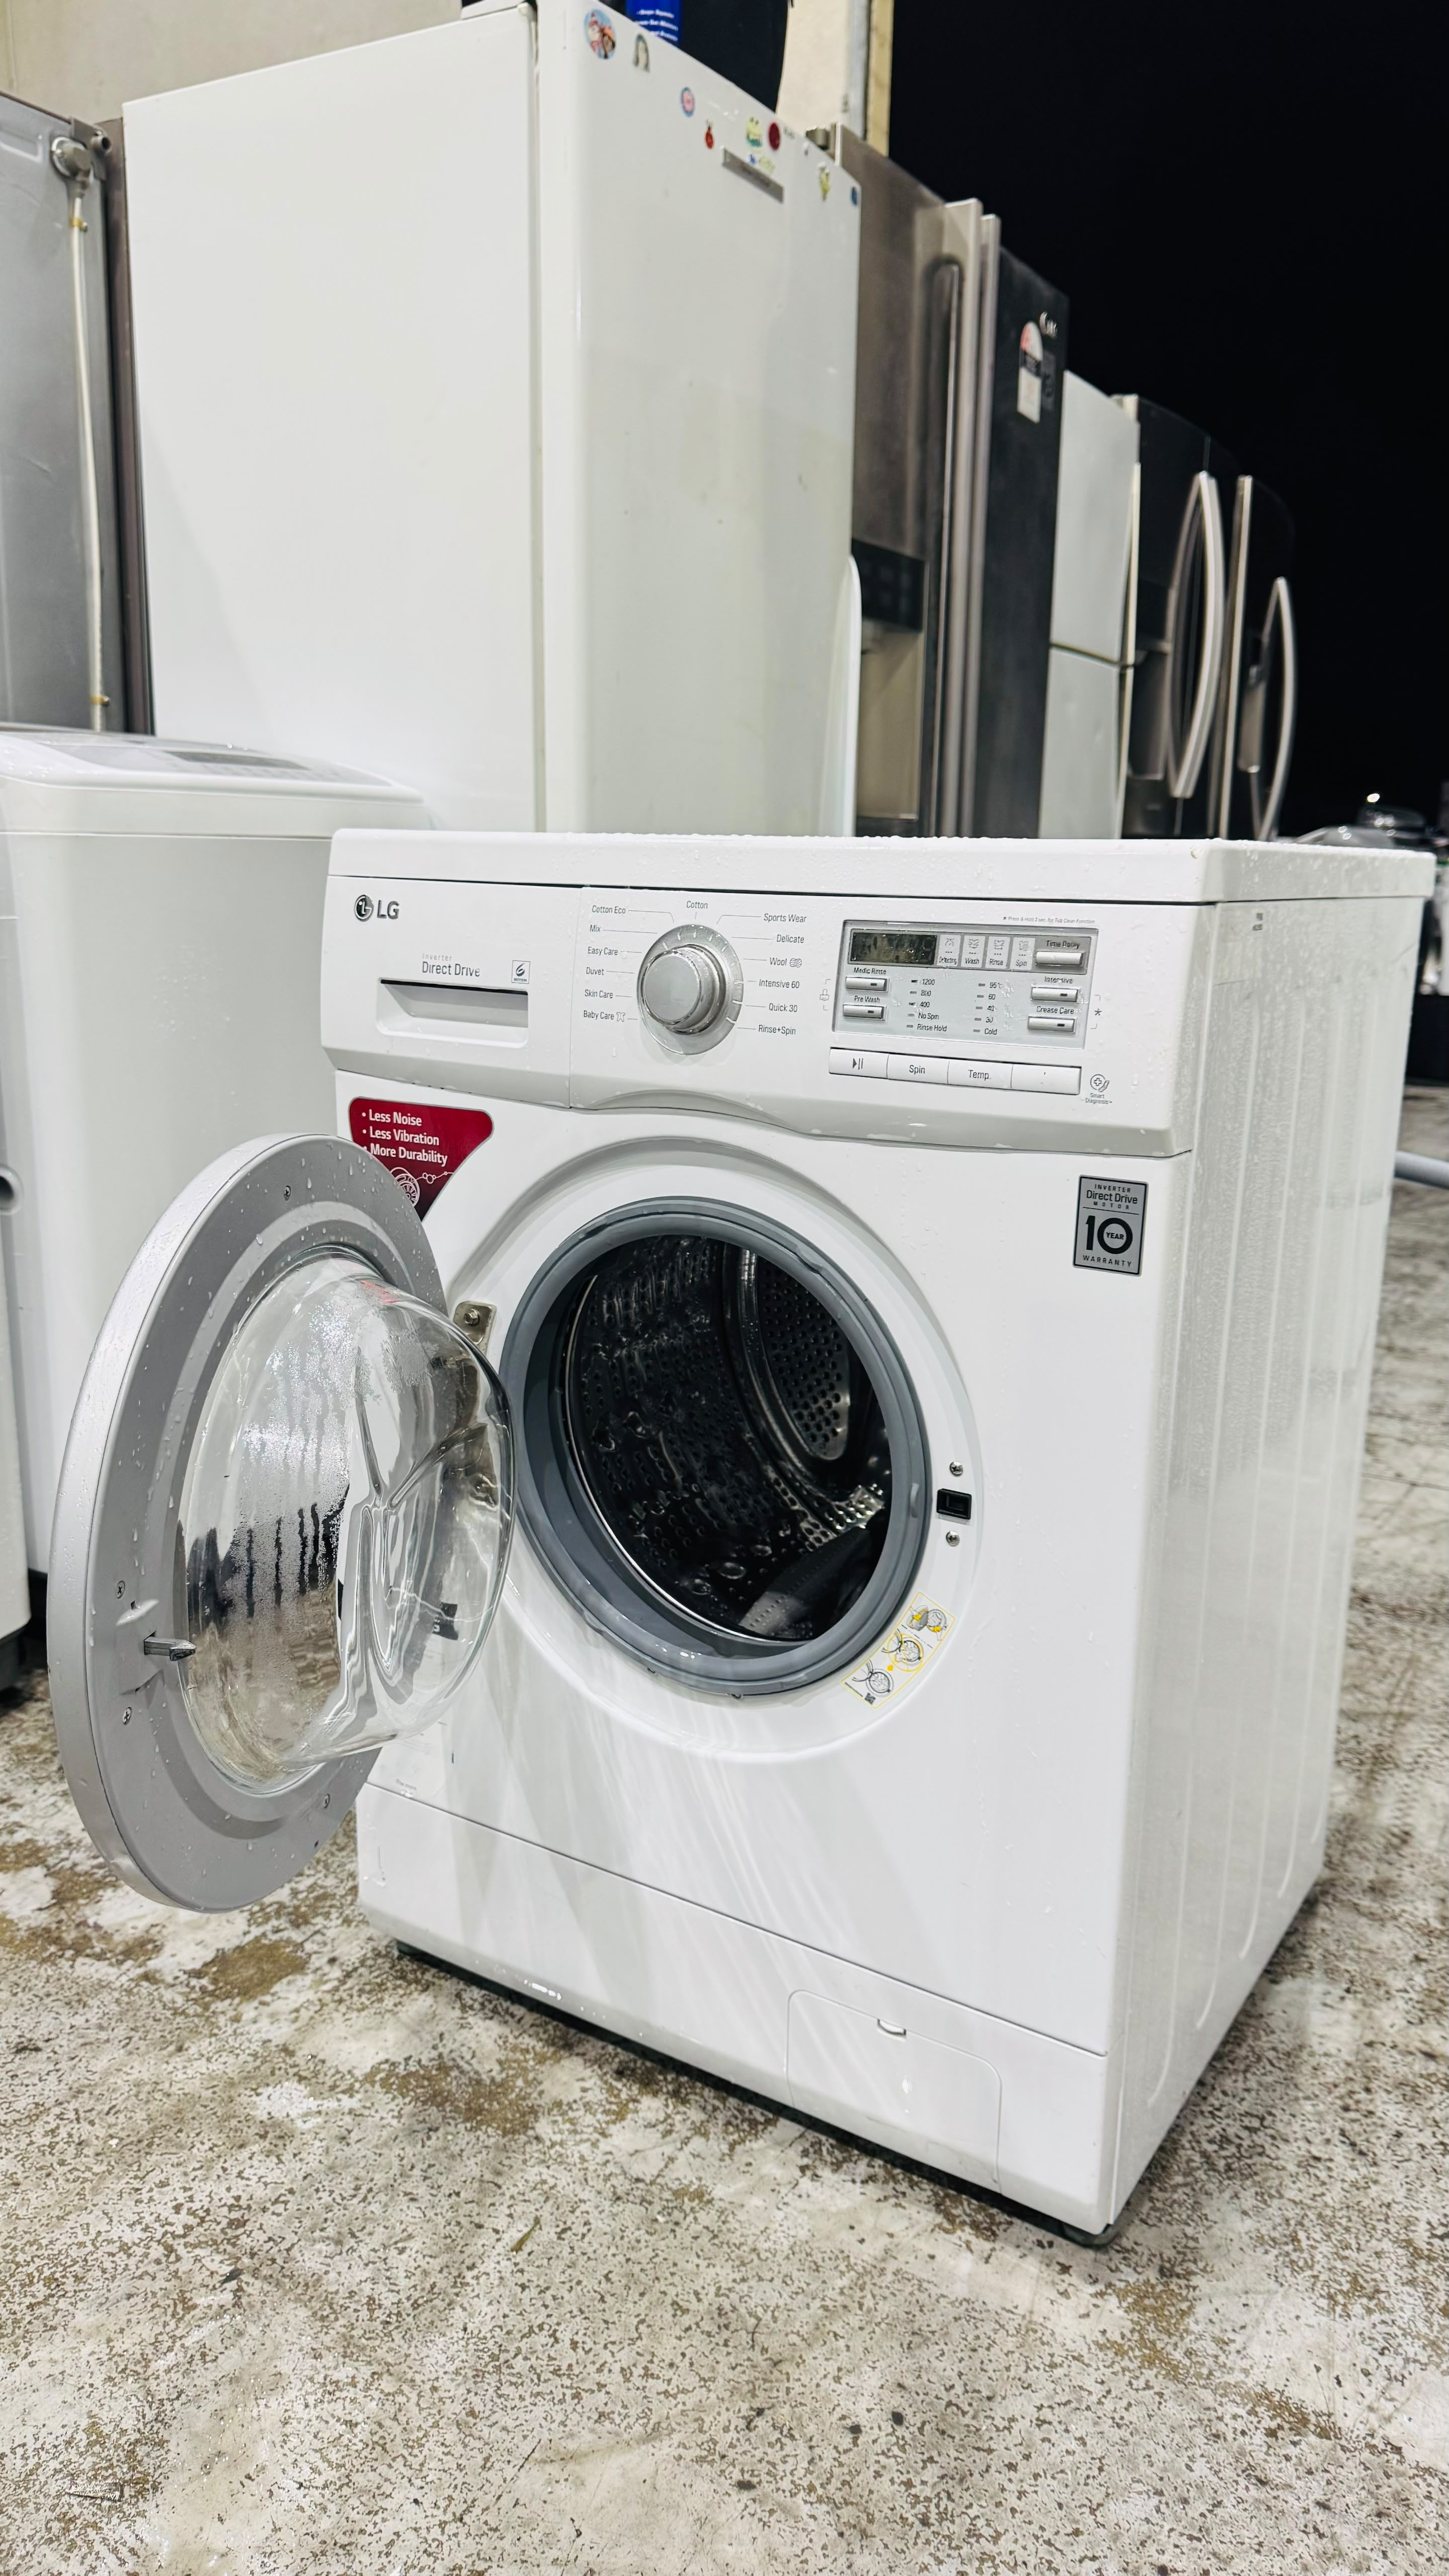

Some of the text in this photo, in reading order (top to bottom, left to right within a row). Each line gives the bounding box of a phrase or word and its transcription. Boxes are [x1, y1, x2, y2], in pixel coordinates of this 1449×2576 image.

[592, 905, 626, 914] Cotton Eco
[686, 900, 708, 909] Cotton
[377, 900, 400, 920] LG
[764, 913, 807, 923] Sports Wear
[590, 924, 601, 932] Mix
[776, 934, 804, 943] Delicate
[1063, 941, 1081, 949] Delay
[588, 946, 618, 956] Easy Care
[770, 957, 787, 966] Wool
[1015, 959, 1027, 968] Spin
[422, 961, 480, 977] Direct Drive
[586, 967, 604, 975] Duvet
[759, 979, 800, 989] Intensive 60
[585, 989, 613, 999] Skin Care
[769, 1003, 797, 1012] Quick 30
[1036, 1006, 1058, 1014] Crease
[584, 1010, 614, 1020] Baby Care
[927, 1013, 939, 1021] Spin
[758, 1024, 796, 1036] Rinse+Spin
[909, 1065, 925, 1075] Spin
[968, 1069, 992, 1081] Temp.
[369, 1109, 422, 1126] Less Noise
[369, 1125, 440, 1146] Less Vibration
[370, 1143, 447, 1167] More Durability
[1094, 1184, 1131, 1193] INVERTER
[1086, 1190, 1138, 1204] Direct Drive
[1093, 1201, 1130, 1210] MOTOR
[1085, 1215, 1133, 1254] 10
[1106, 1232, 1124, 1240] YEAR
[1083, 1255, 1132, 1267] WARRANTY
